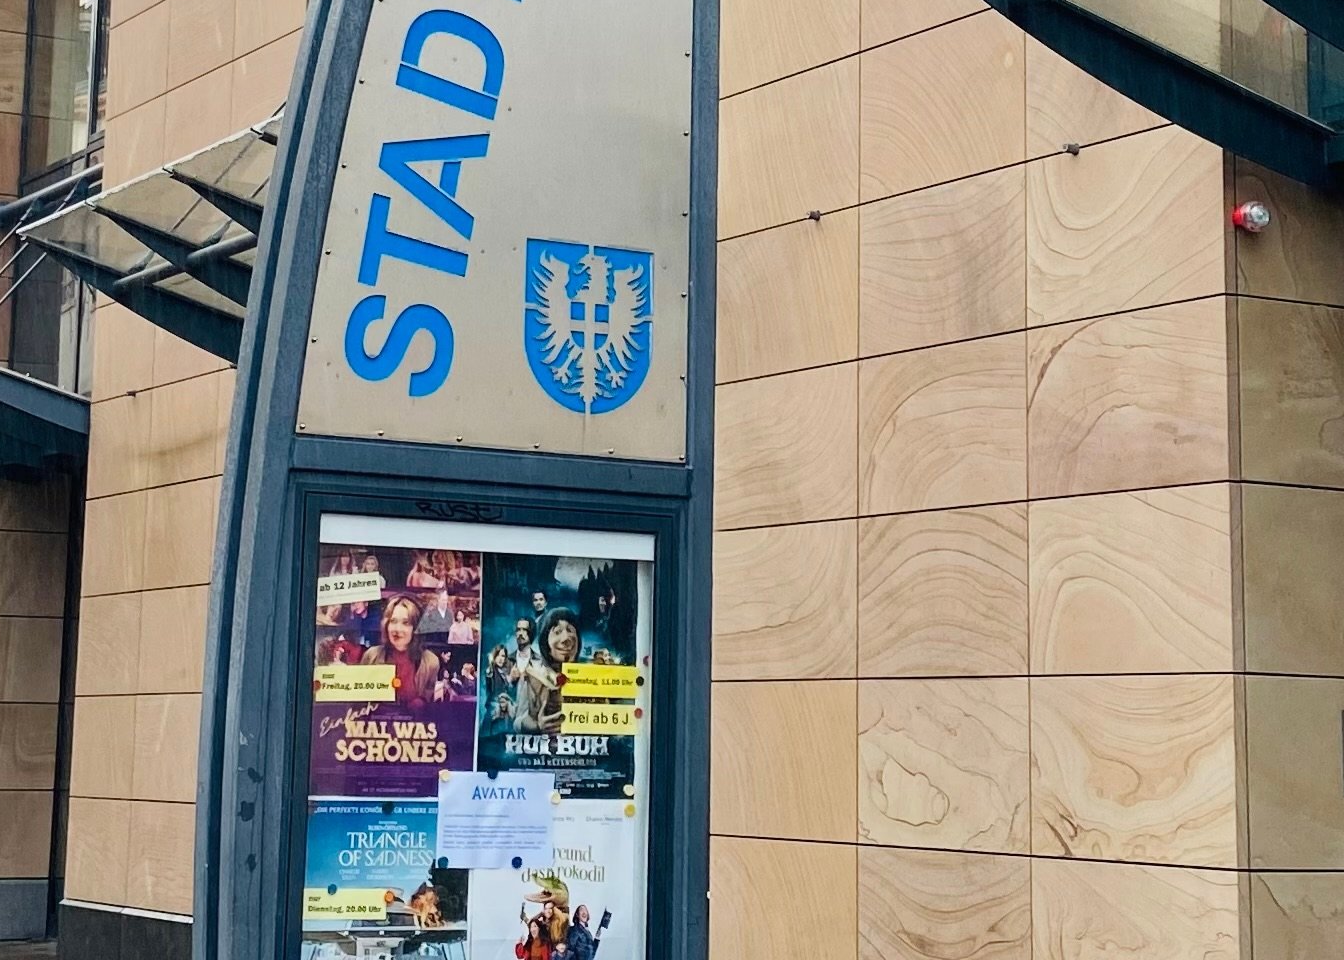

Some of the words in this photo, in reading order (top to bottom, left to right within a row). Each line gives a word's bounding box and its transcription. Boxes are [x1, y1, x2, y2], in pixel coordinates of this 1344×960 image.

[319, 584, 331, 592] ab
[333, 581, 345, 591] 12
[376, 682, 389, 690] Uhr
[569, 711, 590, 724] frei
[593, 713, 608, 724] ab
[612, 714, 619, 725] 6
[345, 721, 392, 738] MAL
[393, 722, 438, 739] WAS
[335, 737, 448, 763] SCHÖNES
[556, 735, 609, 756] BUH
[472, 786, 526, 800] AVATAR
[347, 831, 427, 849] TRIANGLE
[338, 850, 362, 867] OF
[365, 850, 434, 867] SADNESS
[346, 905, 367, 913] 20.00
